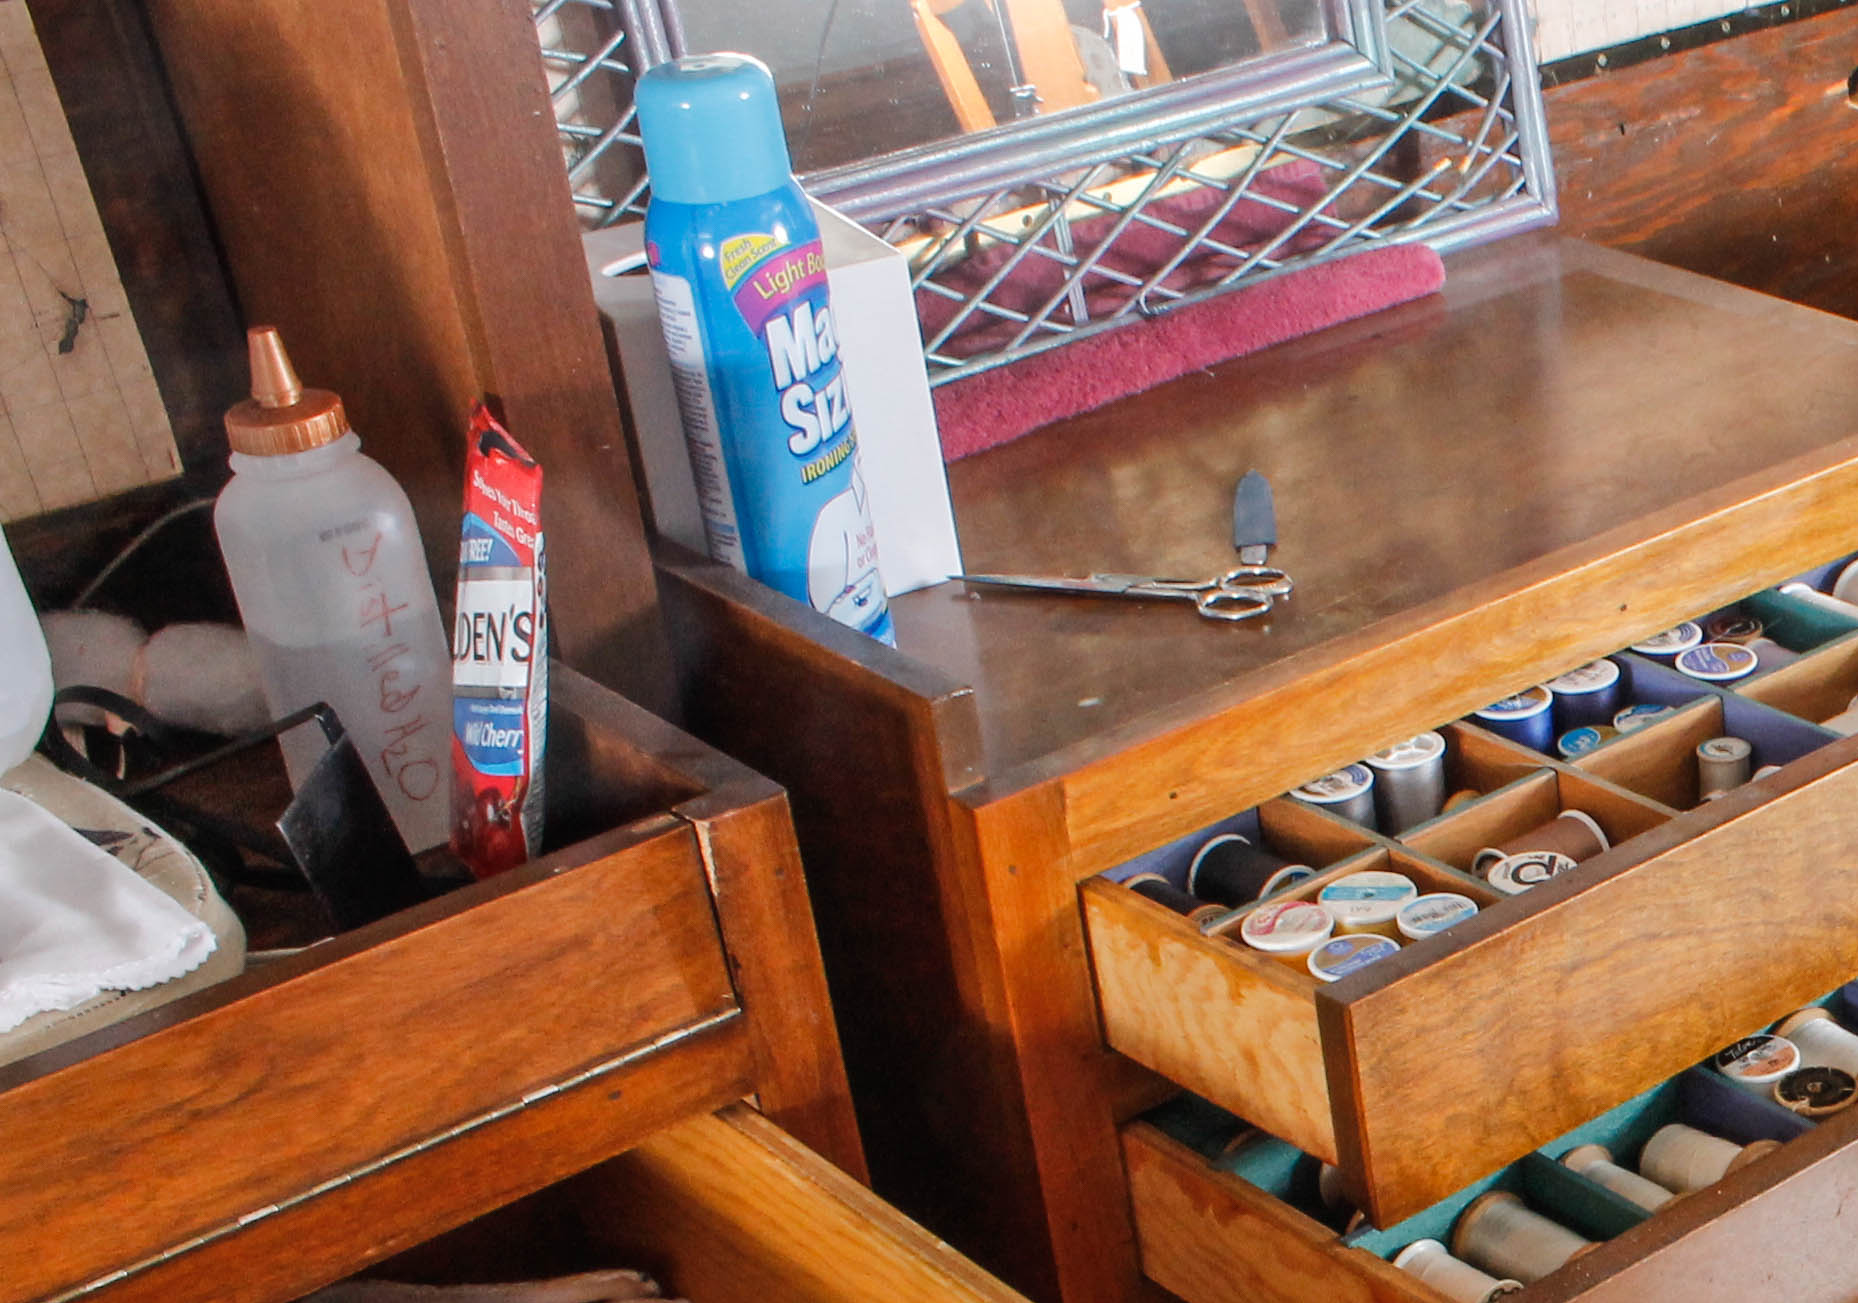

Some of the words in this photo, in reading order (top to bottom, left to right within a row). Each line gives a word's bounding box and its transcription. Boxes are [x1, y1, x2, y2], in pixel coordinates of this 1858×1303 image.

[724, 239, 752, 262] Fresh
[726, 255, 753, 280] Clean
[752, 260, 806, 300] Light
[806, 251, 826, 275] Bo
[765, 300, 838, 391] Ma
[801, 442, 853, 484] IRONING
[342, 532, 420, 713] Distilled
